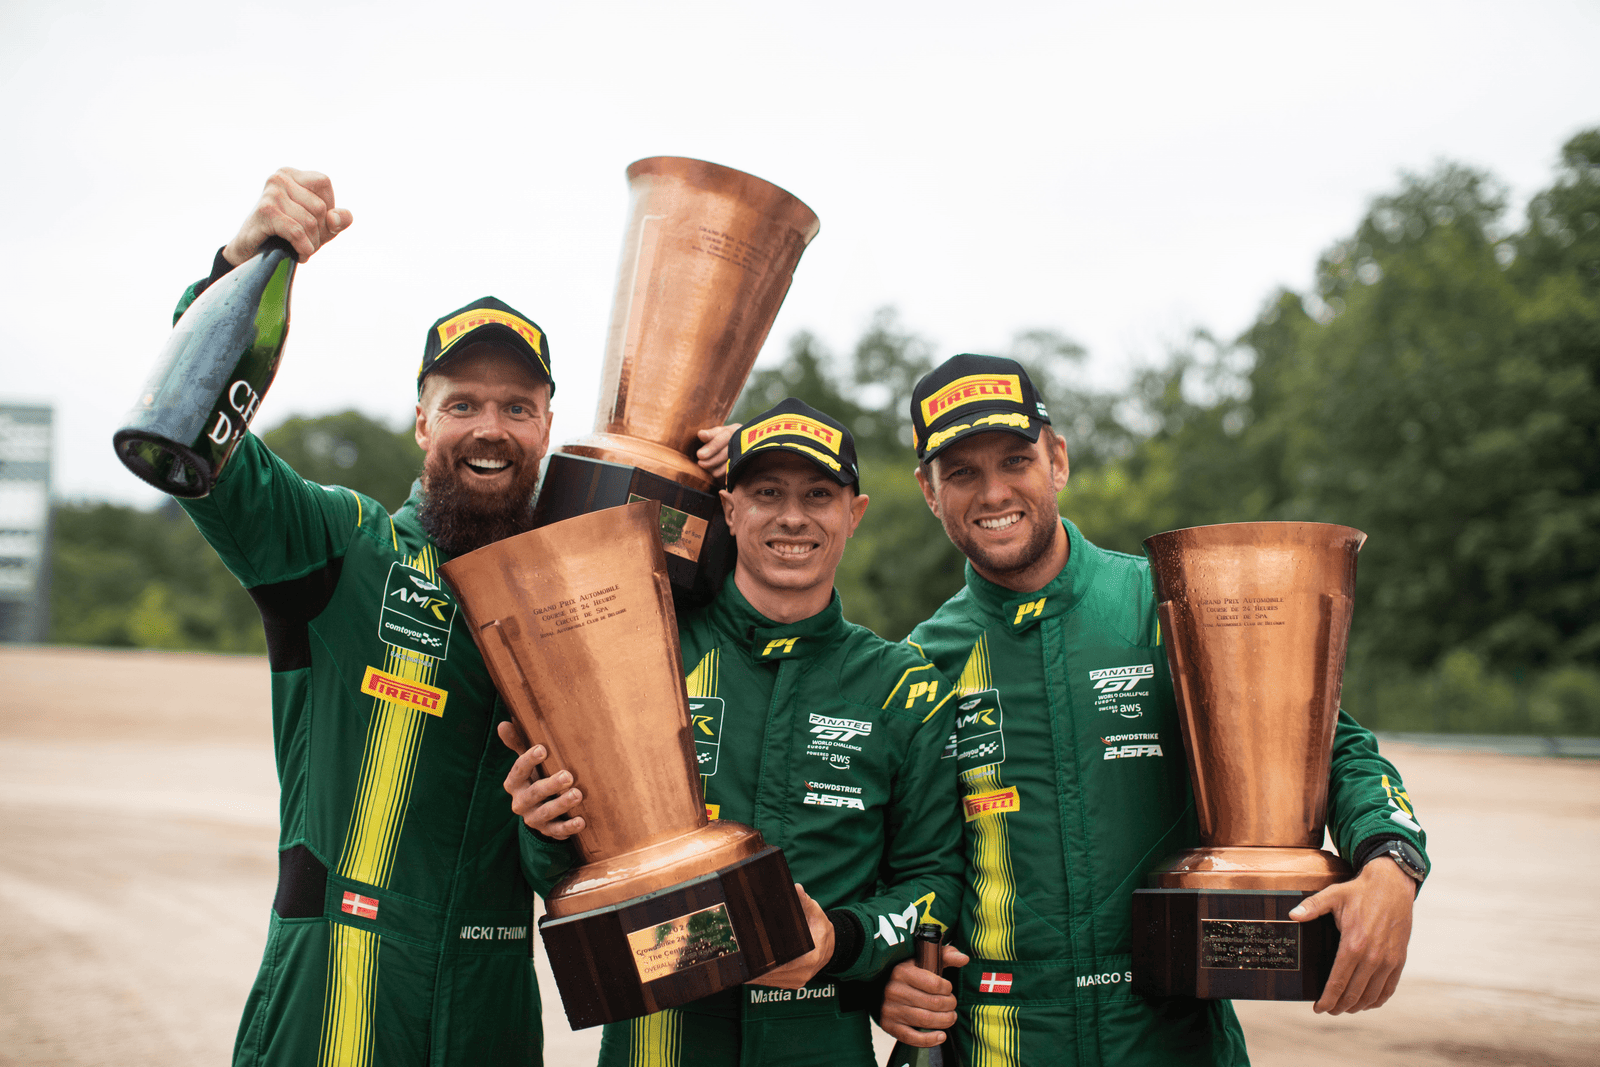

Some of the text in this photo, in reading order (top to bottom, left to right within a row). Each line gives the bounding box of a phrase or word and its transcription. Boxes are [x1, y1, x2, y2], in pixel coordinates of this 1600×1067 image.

[445, 312, 535, 344] PIRLI
[928, 379, 1012, 417] PIRELLI
[747, 417, 834, 444] PIRELLI
[390, 587, 448, 621] AMR
[533, 584, 620, 615] GRAND PRIX AUTOMOBILE
[1014, 597, 1047, 625] P1
[385, 621, 422, 638] comtoyou
[761, 636, 801, 656] P1
[1091, 665, 1153, 679] FANATEC
[368, 673, 441, 710] PIRELLI
[905, 680, 939, 709] P1
[1120, 703, 1141, 713] aws
[810, 715, 872, 730] FANATEC
[833, 741, 862, 752] CHALLENGE
[1105, 733, 1159, 742] CROWDSTRIKE
[830, 753, 851, 765] aws
[808, 781, 862, 794] CROWDSTRIKE
[966, 791, 1014, 817] PIRELLI
[460, 926, 494, 940] NICKI
[1077, 971, 1132, 987] MARCO S
[751, 984, 835, 1004] Mattia Drudi
